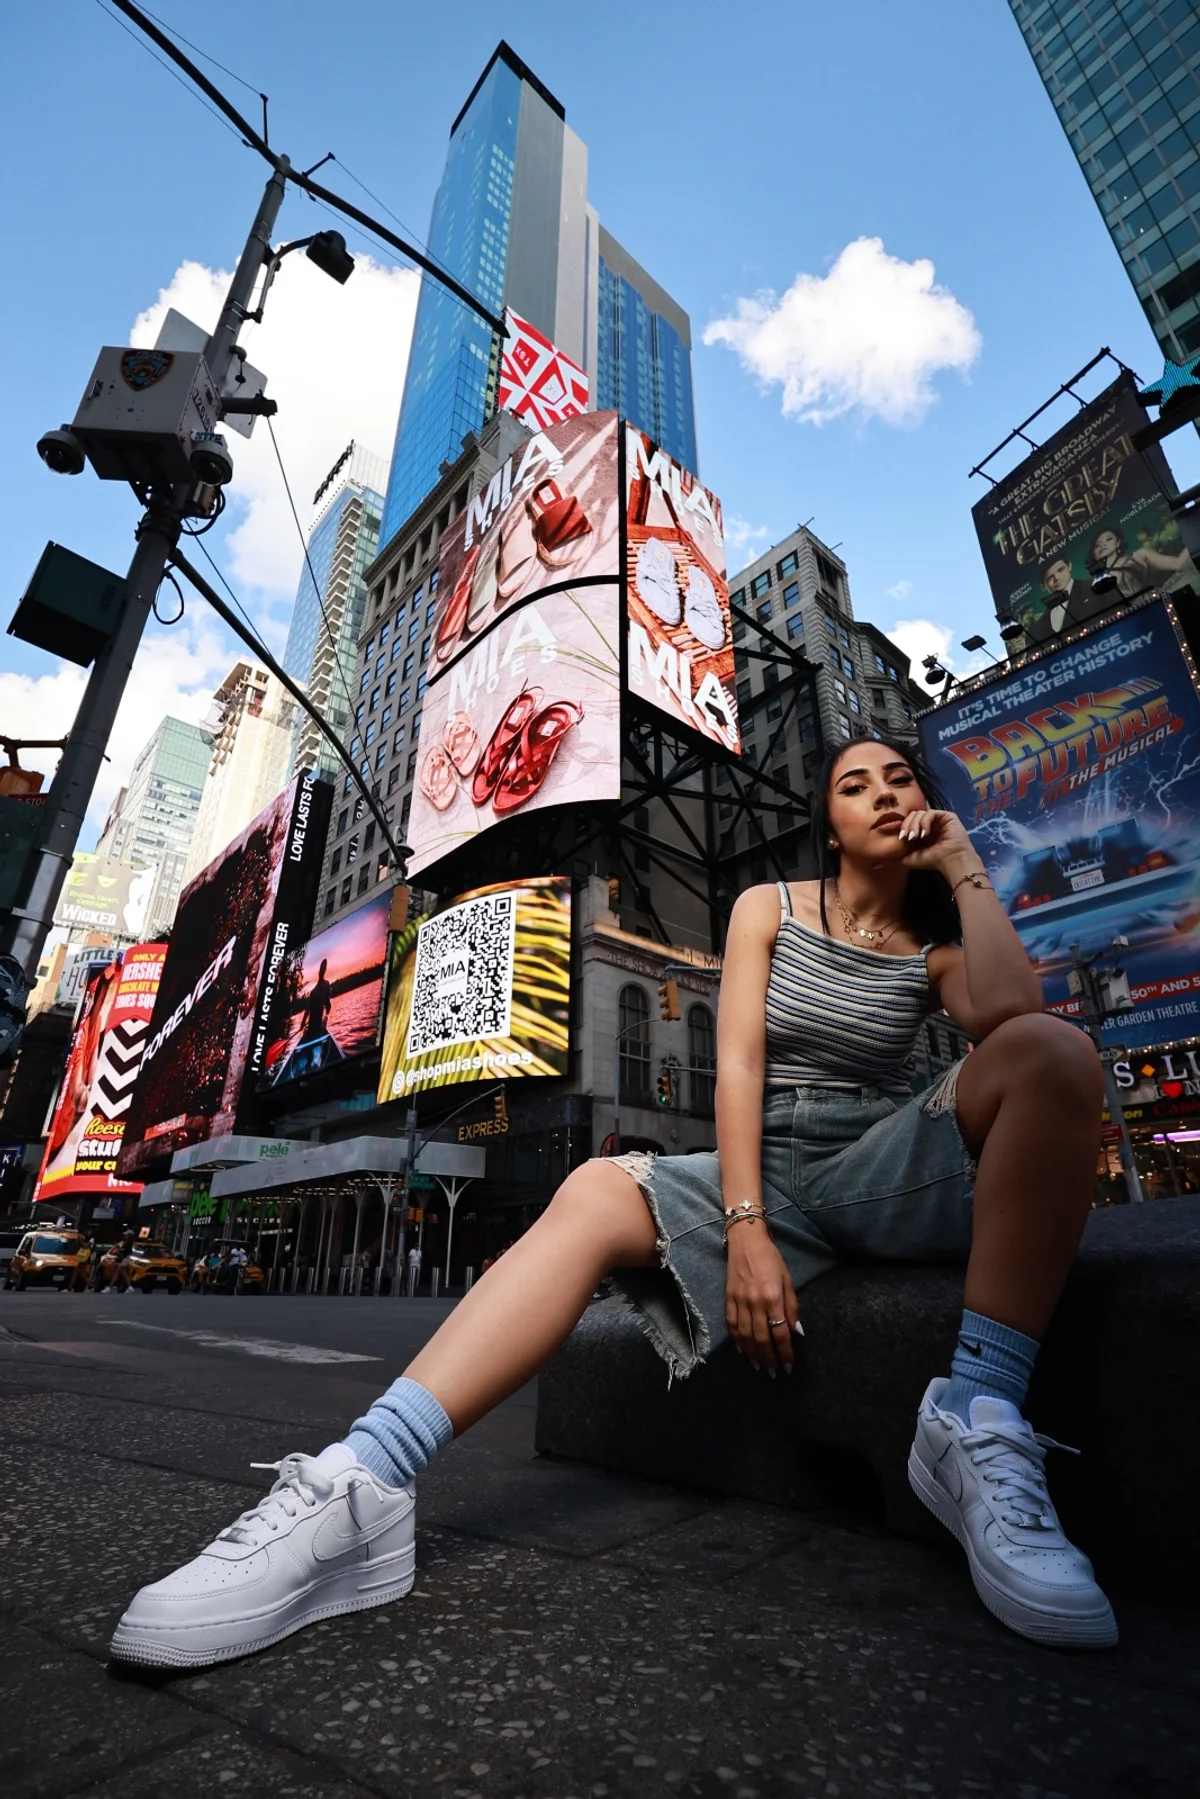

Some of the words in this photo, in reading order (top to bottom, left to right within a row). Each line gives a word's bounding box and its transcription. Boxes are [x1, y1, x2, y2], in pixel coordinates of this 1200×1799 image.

[195, 432, 222, 441] NYPD
[1013, 434, 1098, 505] EXTRAVAGANZA
[1033, 461, 1053, 480] BIG
[1053, 404, 1116, 460] BROADWAY
[463, 459, 565, 552] SHOES
[465, 432, 564, 537] MIA
[627, 428, 722, 540] MIA
[627, 461, 723, 548] SHOES
[993, 507, 1037, 556] THE
[1042, 432, 1135, 516] GREAT
[1016, 465, 1123, 565] GATSBY
[1120, 491, 1163, 524] NOBLEZADA
[1131, 496, 1146, 509] EVA
[1038, 556, 1046, 565] A
[1045, 540, 1067, 558] NEW
[1067, 505, 1112, 541] MUSICAL
[445, 642, 559, 729] SHOES
[447, 604, 558, 712] MIA
[629, 619, 737, 728] MIA
[938, 708, 1002, 740] MUSICAL
[1003, 670, 1077, 709] THEATER
[1077, 631, 1155, 676] HISTORY
[957, 699, 984, 719] IT'S
[987, 680, 1022, 704] TIME
[1024, 670, 1047, 686] TO
[1049, 633, 1122, 675] CHANGE
[631, 664, 738, 744] SHOES
[944, 682, 1150, 780] BACK
[973, 767, 1013, 802] TO
[1016, 696, 1173, 801] FUTURE
[974, 792, 1013, 824] THE
[1068, 763, 1098, 790] THE
[1103, 725, 1175, 771] MUSICAL
[290, 828, 306, 862] LOVE
[296, 790, 313, 829] LASTS
[73, 949, 114, 965] LITTLE
[133, 953, 157, 962] ONLY
[267, 921, 290, 985] FOREVER
[440, 960, 466, 980] MIA
[1131, 985, 1157, 1000] 50TH
[1160, 978, 1190, 994] AND
[139, 935, 237, 1072] FOREVER
[1116, 1010, 1156, 1027] GARDEN
[1156, 1000, 1199, 1020] THEATRE
[407, 1052, 533, 1087] @shopmiashoes
[76, 1160, 103, 1171] your
[458, 1119, 510, 1142] EXPRESS
[192, 1215, 212, 1226] SOCCER
